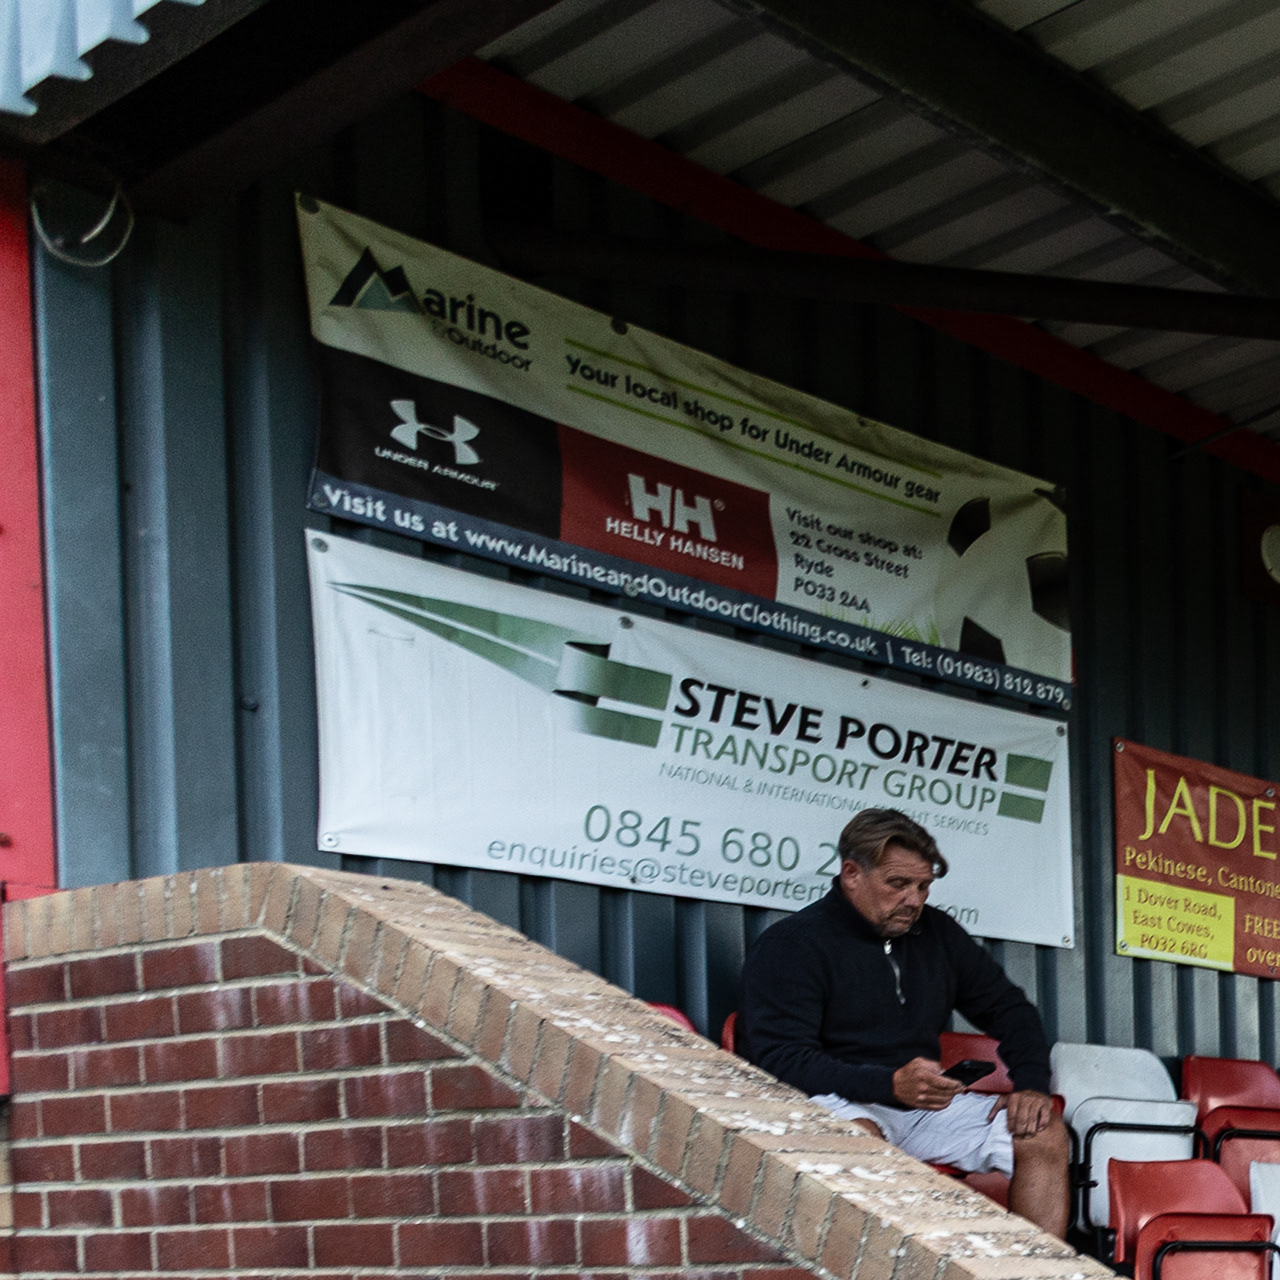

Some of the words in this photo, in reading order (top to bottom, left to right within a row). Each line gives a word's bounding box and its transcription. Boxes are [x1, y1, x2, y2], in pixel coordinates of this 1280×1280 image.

[565, 355, 619, 388] Your
[625, 374, 679, 410] local
[683, 400, 734, 432] shop
[740, 417, 769, 443] for
[774, 429, 833, 464] Under
[836, 453, 902, 490] Armour
[905, 479, 941, 503] gear
[374, 446, 430, 470] UNDER
[432, 464, 500, 491] ARMOUR
[605, 516, 665, 547] HELLY
[669, 535, 745, 571] HANSEN
[786, 507, 822, 532] Visit
[826, 523, 854, 541] our
[858, 531, 899, 555] shop
[789, 531, 813, 549] 22
[816, 538, 860, 563] Cross
[863, 551, 910, 579] Street
[793, 552, 836, 579] Ryde
[323, 483, 387, 522] Visit
[393, 508, 425, 532] us
[431, 519, 459, 542] at
[900, 645, 932, 669] Tel:
[935, 653, 1000, 690] (01983)
[1003, 672, 1033, 697] 812
[1036, 682, 1064, 704] 879
[793, 577, 836, 602] PO33
[839, 590, 871, 614] 2AA
[673, 688, 823, 744] STEVE
[836, 715, 998, 782] PORTER
[658, 761, 738, 791] NATIONAL
[743, 779, 753, 793] &
[757, 781, 867, 812] INTERNATIONAL
[670, 723, 878, 790] TRANSPORT
[882, 769, 996, 812] GROUP
[584, 804, 700, 857] 0845
[721, 828, 800, 871] 680
[933, 814, 990, 836] SERVICES
[1138, 769, 1278, 861] JADE
[1124, 846, 1213, 886] Pekinese,
[1125, 886, 1136, 901] 1
[1138, 888, 1180, 911] Dover
[1183, 898, 1223, 921] Road,
[1133, 909, 1167, 930] East
[1171, 915, 1215, 940] Cowes,
[1140, 933, 1178, 954] PO32
